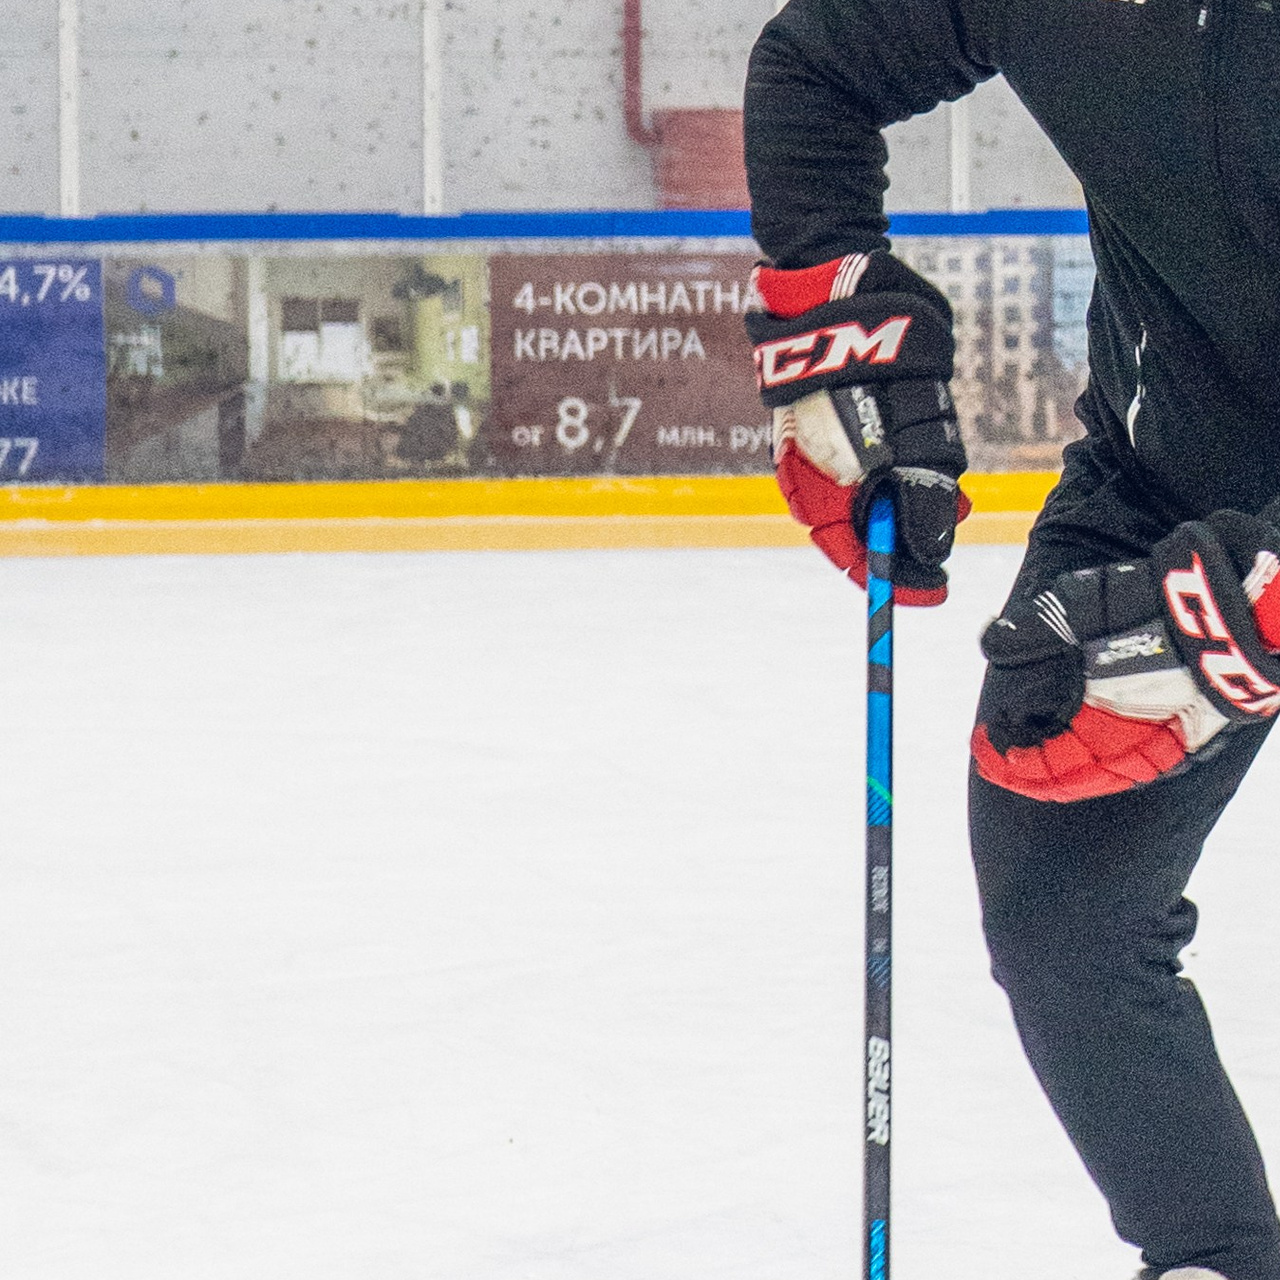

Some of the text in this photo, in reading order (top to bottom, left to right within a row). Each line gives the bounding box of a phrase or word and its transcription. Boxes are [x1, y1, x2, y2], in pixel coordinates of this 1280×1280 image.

[0, 265, 91, 306] 4,7%
[513, 281, 765, 315] 4-КОМНАТНА
[514, 327, 706, 361] КВАРТИРА
[754, 316, 912, 388] CM
[511, 424, 543, 447] от
[555, 396, 643, 453] 8,7
[655, 424, 722, 447] млн.
